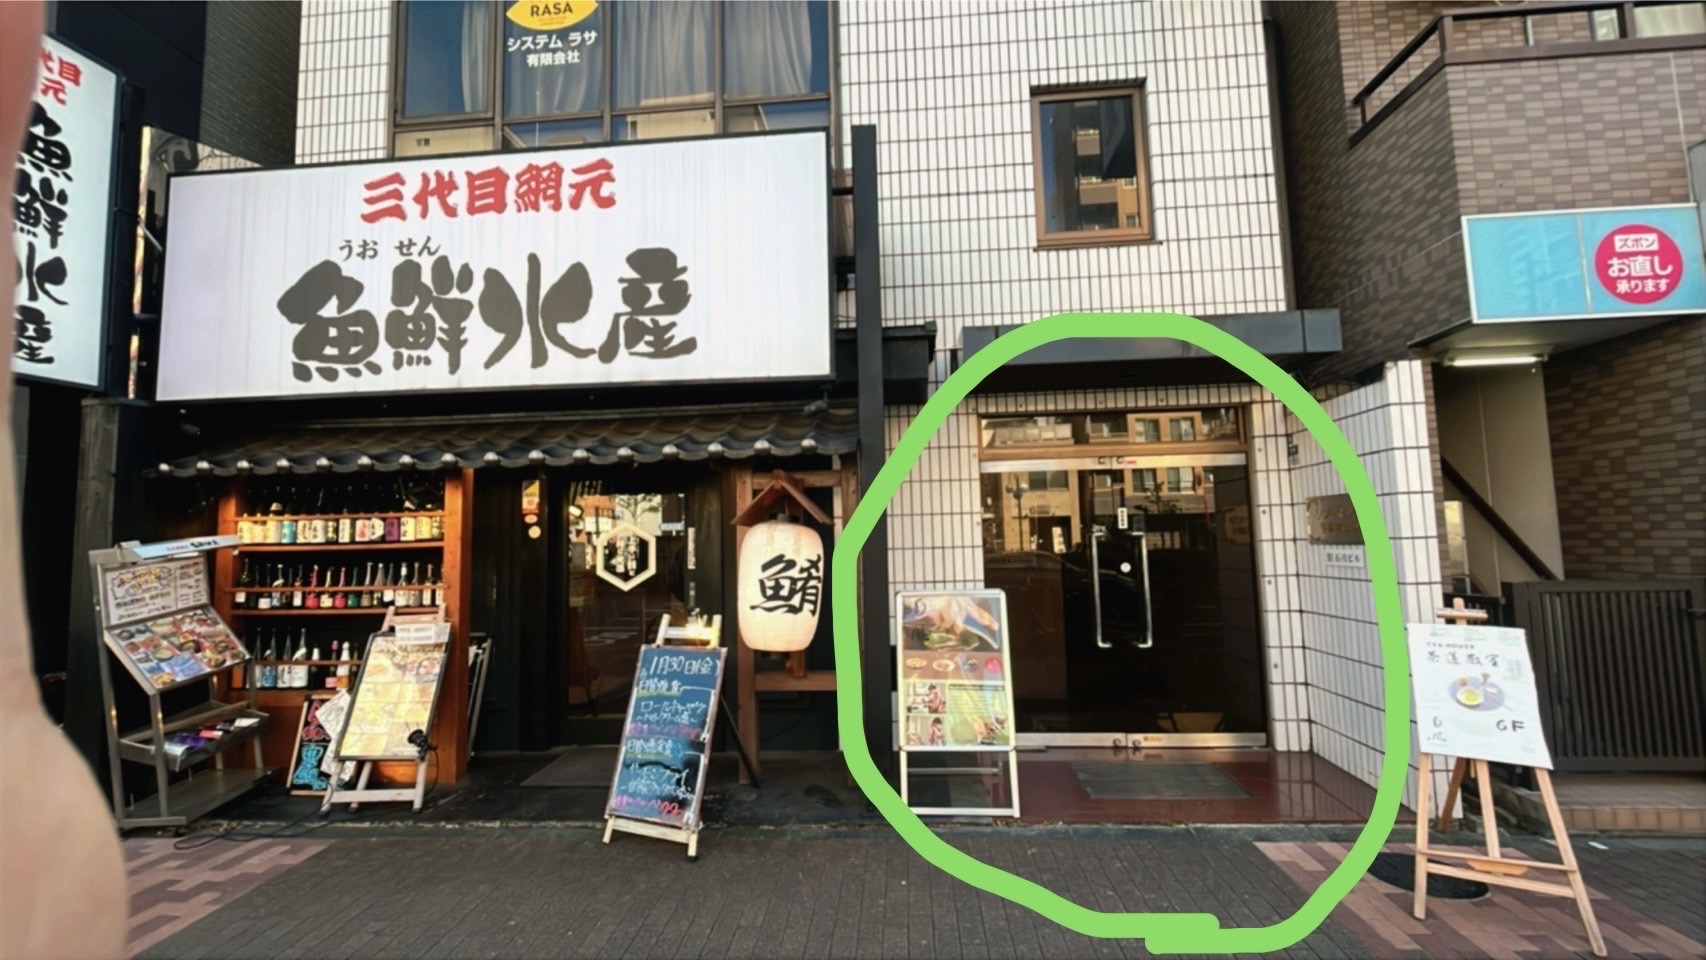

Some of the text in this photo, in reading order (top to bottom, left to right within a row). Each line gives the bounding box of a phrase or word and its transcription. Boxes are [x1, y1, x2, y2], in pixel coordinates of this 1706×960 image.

[530, 2, 573, 17] RASA
[507, 30, 598, 52] システム ラサ
[526, 49, 580, 67] 有限会社
[361, 158, 617, 223] 三代目網元
[338, 236, 440, 261] うお せん
[1607, 255, 1673, 277] お直し
[1616, 278, 1670, 294] 承ります
[277, 247, 697, 381] 魚鮮水産
